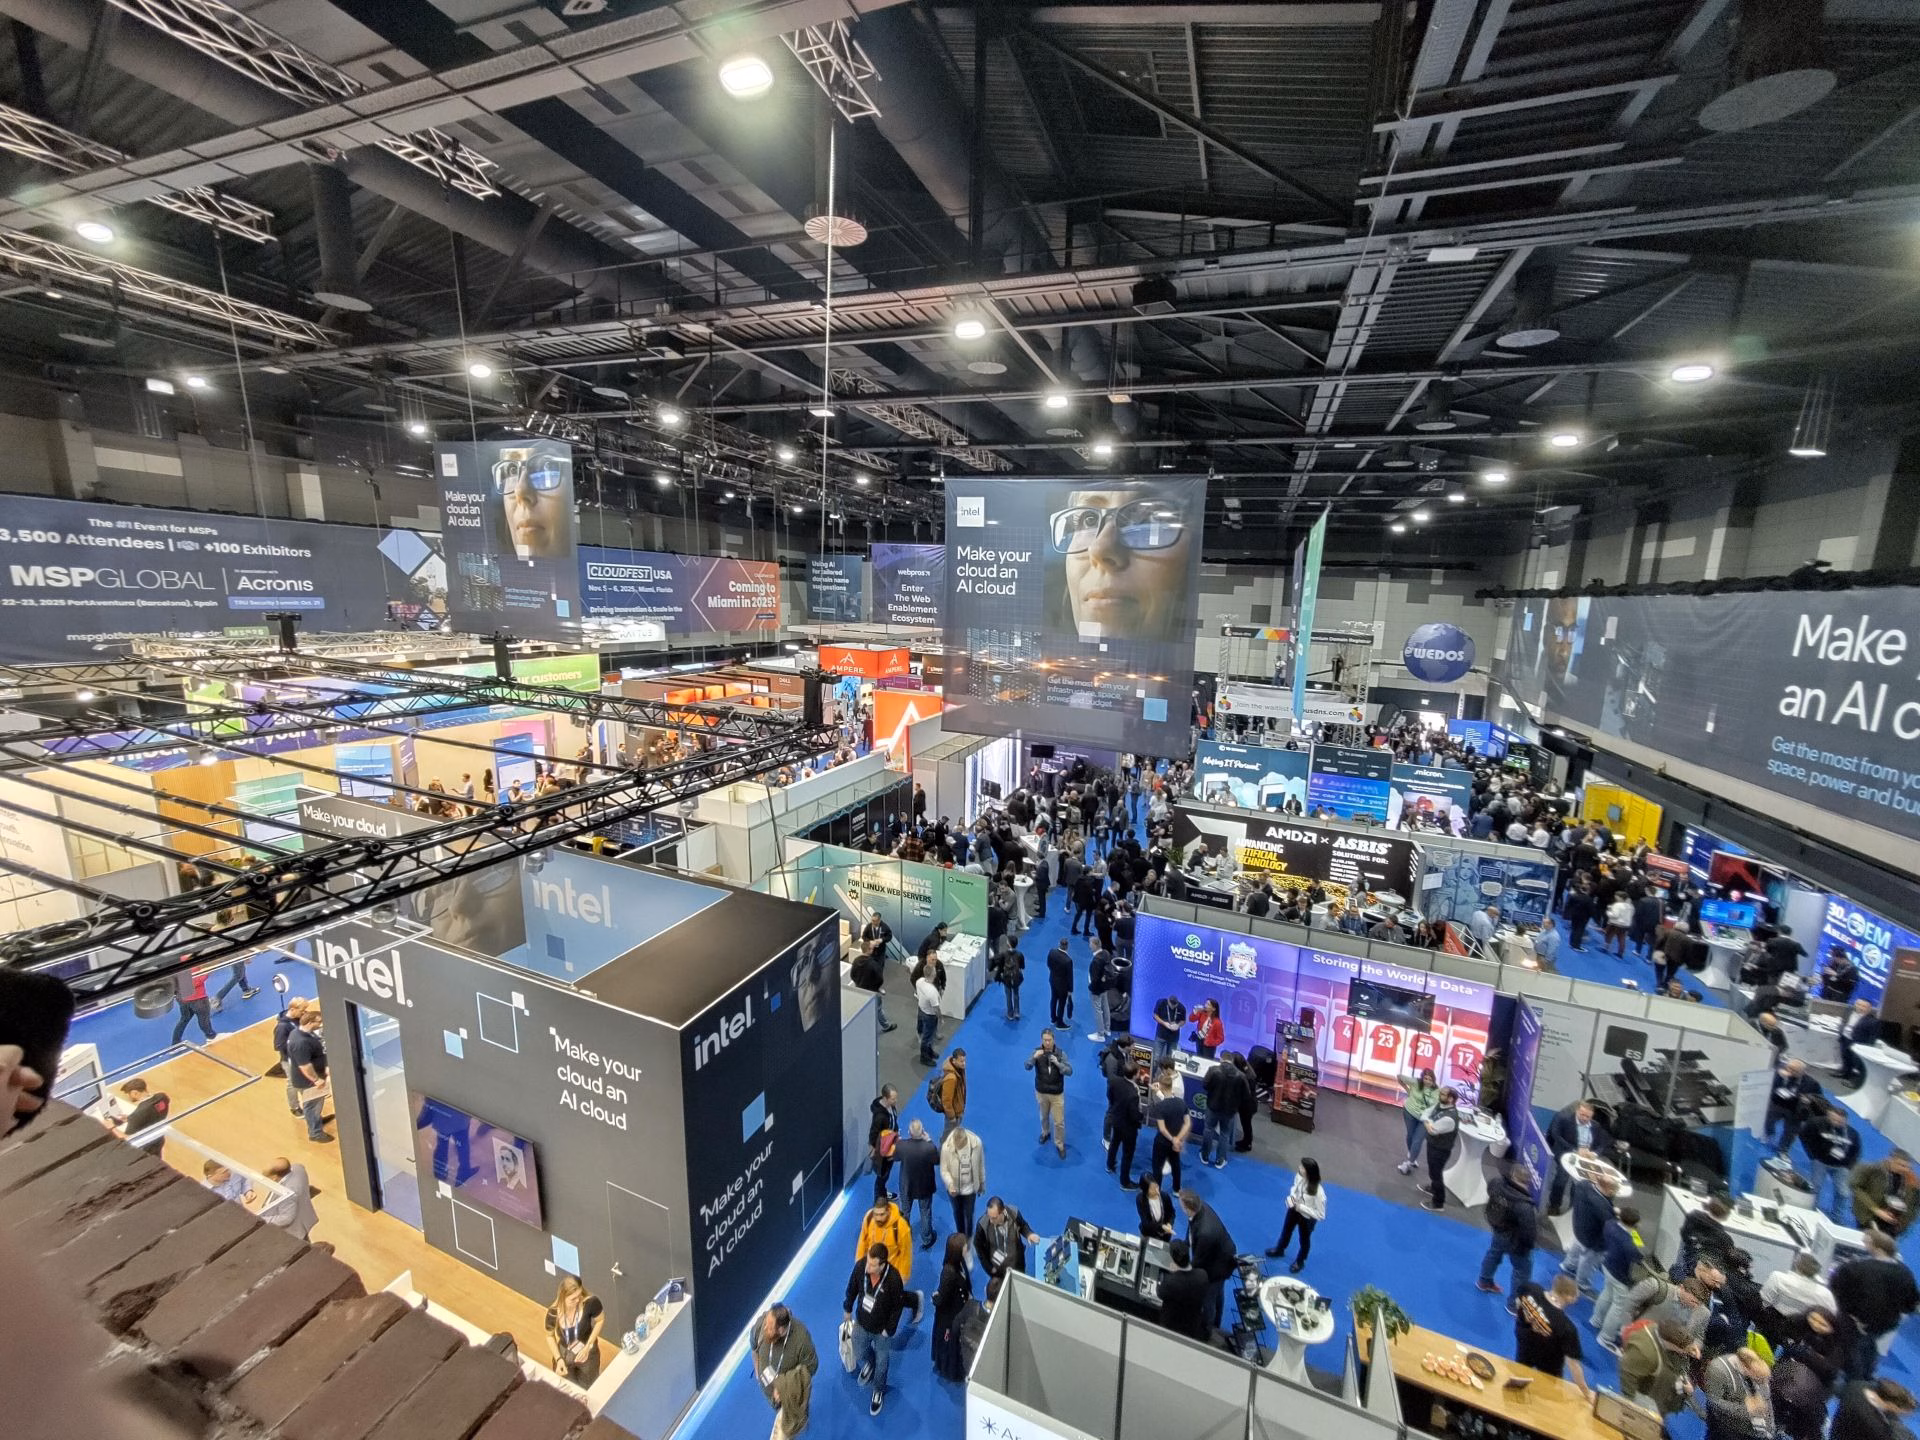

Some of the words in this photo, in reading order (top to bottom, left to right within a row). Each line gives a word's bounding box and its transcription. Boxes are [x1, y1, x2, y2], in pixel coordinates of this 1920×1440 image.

[445, 491, 467, 502] Make
[467, 492, 486, 504] your
[447, 503, 469, 515] cloud
[469, 505, 481, 515] an
[961, 507, 980, 516] intel
[88, 518, 114, 528] The
[134, 522, 169, 533] Event
[170, 524, 187, 534] for
[188, 526, 218, 536] MSPs
[448, 515, 458, 526] AI
[459, 516, 480, 527] cloud
[65, 533, 165, 550] Attendees
[203, 542, 241, 554] +100
[242, 544, 312, 558] Exhibitors
[957, 546, 996, 562] Make
[998, 549, 1032, 564] your
[9, 565, 217, 590] MSPGLOBAL
[589, 566, 651, 579] CLOUDFEST
[653, 570, 673, 580] USA
[957, 563, 997, 578] cloud
[999, 566, 1018, 579] an
[237, 575, 314, 592] Acronis
[728, 580, 766, 596] Coming
[766, 582, 776, 593] to
[901, 584, 925, 593] Enter
[956, 579, 973, 594] AI
[975, 580, 1016, 596] cloud
[194, 600, 219, 608] Spain
[707, 594, 741, 608] Miami
[741, 595, 751, 608] in
[751, 596, 777, 608] 2025!
[894, 593, 910, 602] The
[911, 595, 931, 603] Web
[888, 603, 938, 614] Enablement
[891, 613, 936, 625] Ecosystem
[1791, 614, 1908, 667] Make
[1413, 648, 1465, 662] WEDOS
[531, 671, 583, 684] customers
[1061, 677, 1074, 686] the
[1074, 680, 1093, 688] most
[1113, 683, 1130, 691] your
[1264, 704, 1289, 712] waitlist
[1778, 685, 1828, 722] an
[1830, 680, 1889, 733] AI
[1771, 735, 1796, 752] Get
[1796, 742, 1820, 763] the
[1819, 750, 1859, 770] most
[1859, 756, 1900, 781] from
[1766, 757, 1808, 785] space,
[1808, 770, 1856, 796] power
[1856, 784, 1894, 807] and
[303, 803, 331, 823] Make
[331, 812, 355, 829] your
[356, 817, 387, 838] cloud
[1266, 826, 1303, 843] AMD
[1332, 836, 1389, 856] ASBIS
[1332, 850, 1371, 862] SOLUTIONS
[847, 878, 861, 888] FOR
[862, 881, 886, 894] LINUX
[886, 885, 901, 897] WEB
[902, 890, 932, 904] SERVERS
[532, 877, 613, 929] intel
[1170, 945, 1215, 963] wasabi
[315, 932, 406, 1007] intel
[1312, 954, 1360, 973] Storing
[1361, 963, 1384, 977] the
[1386, 968, 1438, 988] World's
[694, 994, 756, 1072] intel
[1342, 1024, 1352, 1039] 4
[1377, 1032, 1395, 1049] 23
[553, 1031, 601, 1068] Make
[601, 1053, 643, 1084] your
[1416, 1041, 1433, 1058] 20
[1625, 1049, 1643, 1062] ES
[1457, 1051, 1474, 1067] 17
[1285, 1065, 1318, 1079] LEGEND
[556, 1063, 604, 1096] cloud
[605, 1080, 628, 1105] an
[559, 1089, 579, 1113] AI
[579, 1094, 628, 1132] cloud
[703, 1175, 744, 1227] Make
[744, 1139, 775, 1184] your
[705, 1198, 744, 1251] cloud
[744, 1177, 764, 1206] an
[707, 1249, 727, 1280] AI
[725, 1202, 764, 1262] cloud
